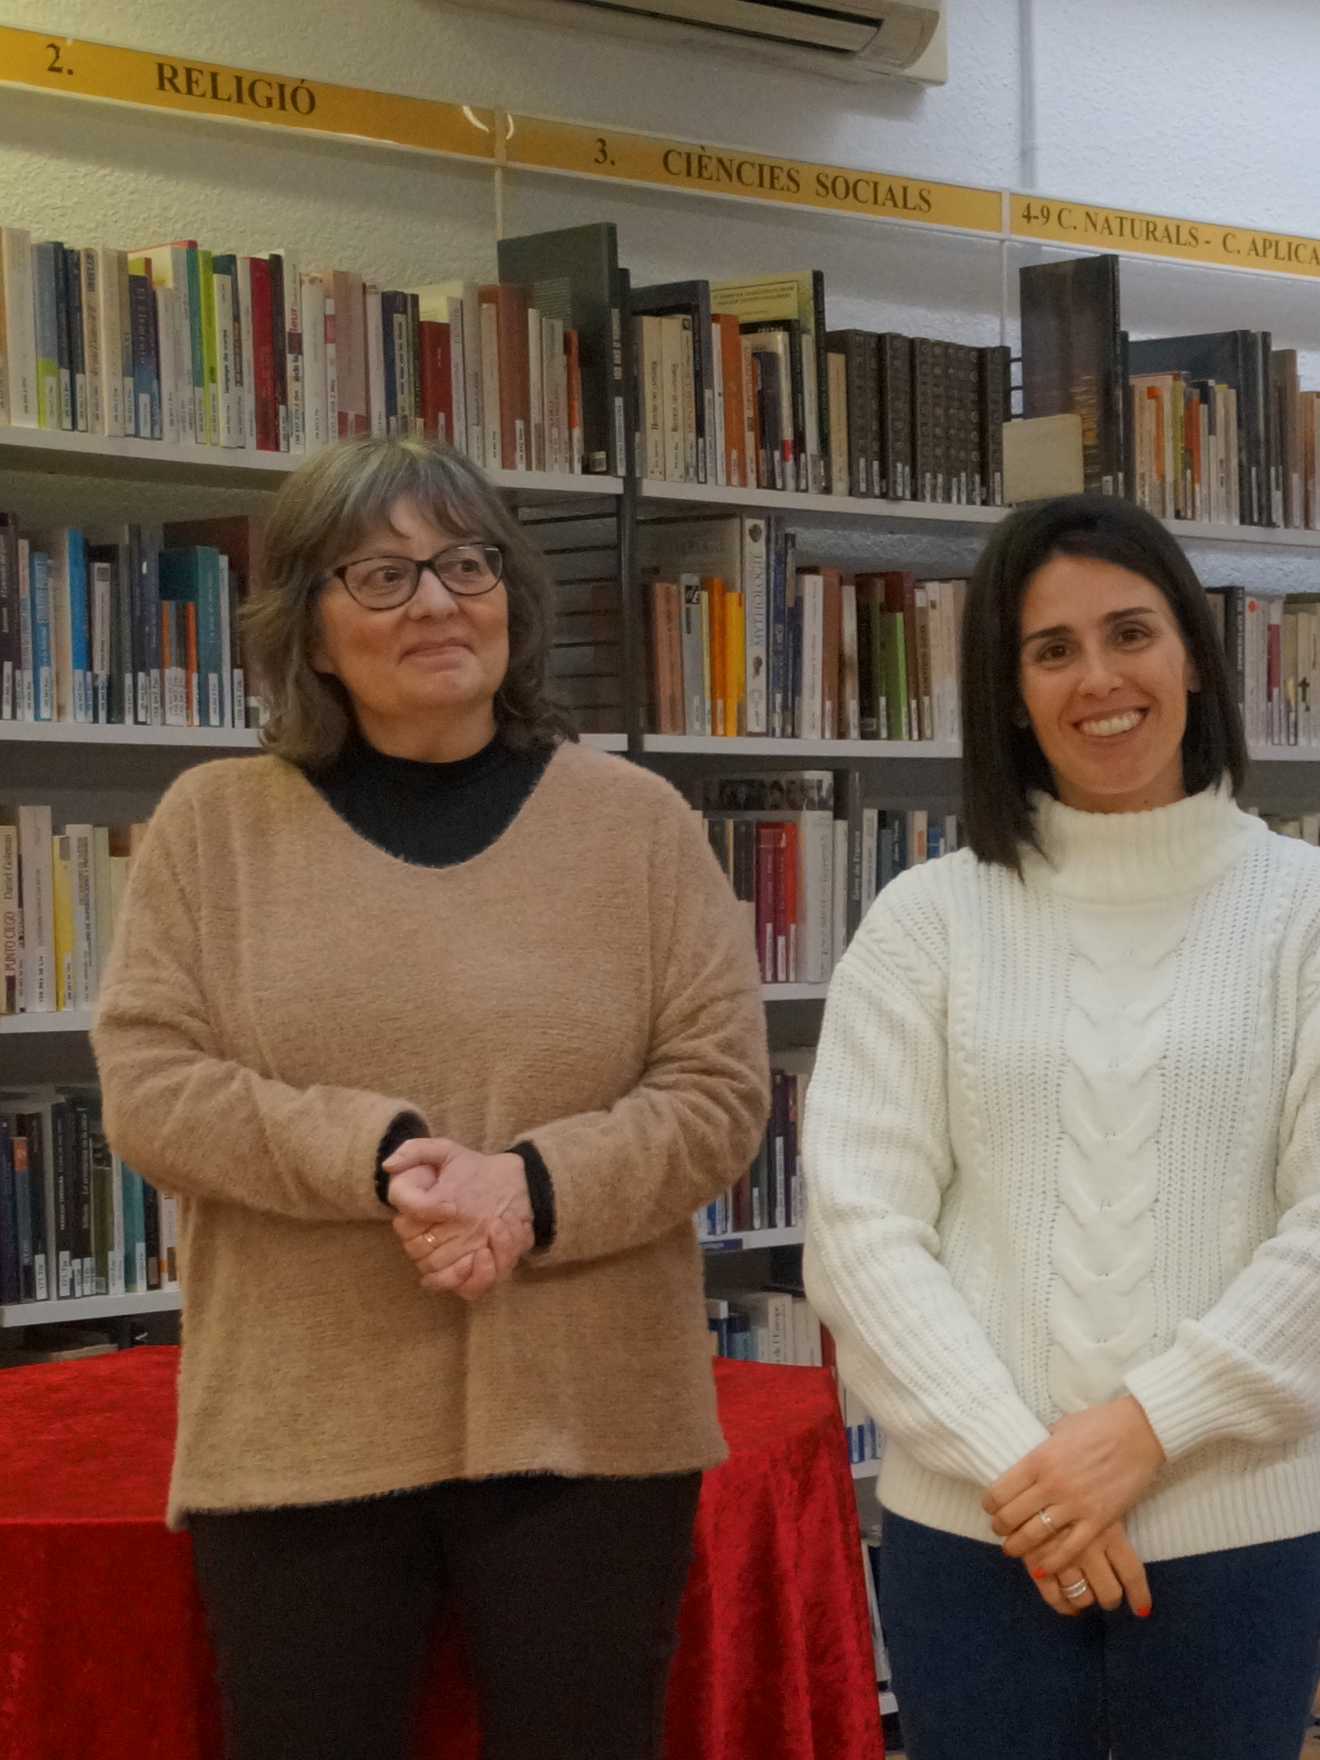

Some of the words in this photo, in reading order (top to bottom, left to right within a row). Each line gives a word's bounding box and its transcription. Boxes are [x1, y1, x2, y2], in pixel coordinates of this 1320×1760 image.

[46, 43, 74, 76] 2.
[155, 61, 316, 115] RELIGIÓ
[594, 138, 615, 166] 3.
[662, 145, 800, 194] CIÈNCIES
[815, 172, 932, 213] SOCIALS
[1057, 208, 1077, 232] C.
[1084, 211, 1200, 248] NATURALS
[1222, 232, 1242, 256] C.
[748, 552, 764, 648] MYTHOLOGIE
